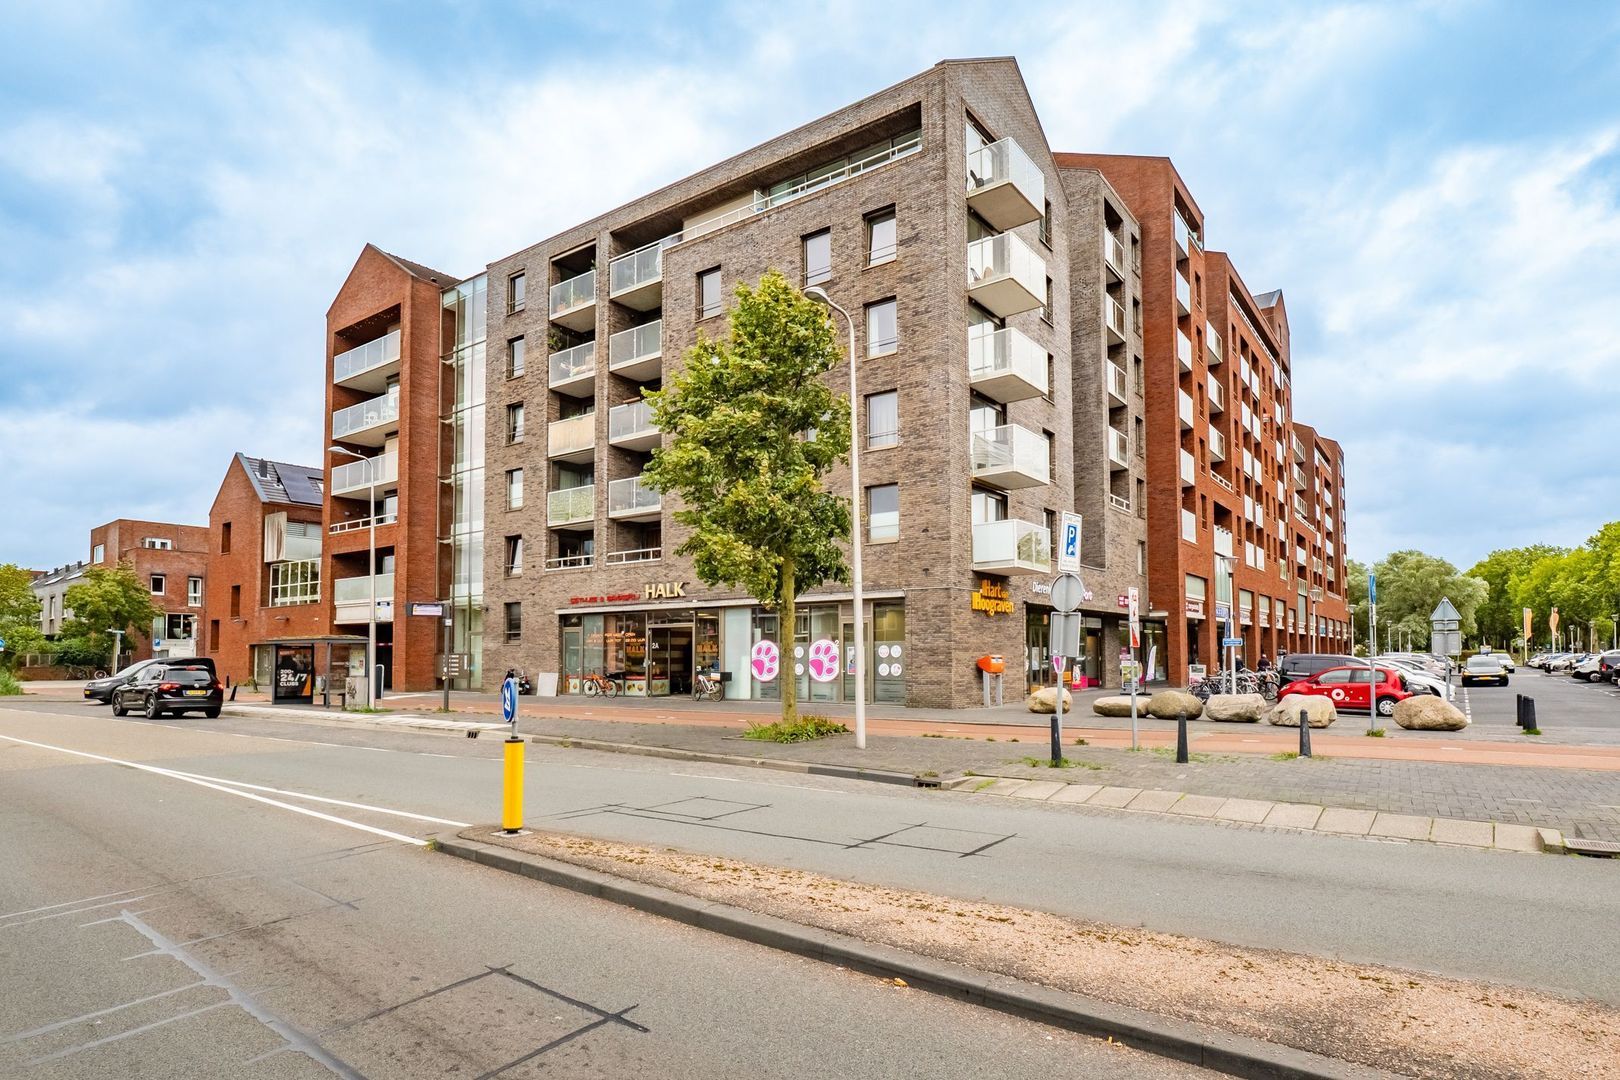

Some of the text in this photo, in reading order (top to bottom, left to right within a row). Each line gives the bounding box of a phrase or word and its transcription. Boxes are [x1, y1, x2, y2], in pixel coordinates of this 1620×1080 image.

[1068, 526, 1075, 543] P
[645, 581, 686, 599] HALK
[981, 580, 1002, 598] Hart
[972, 592, 1014, 617] Hoograven
[834, 639, 840, 647] 2
[280, 673, 308, 682] 24/7
